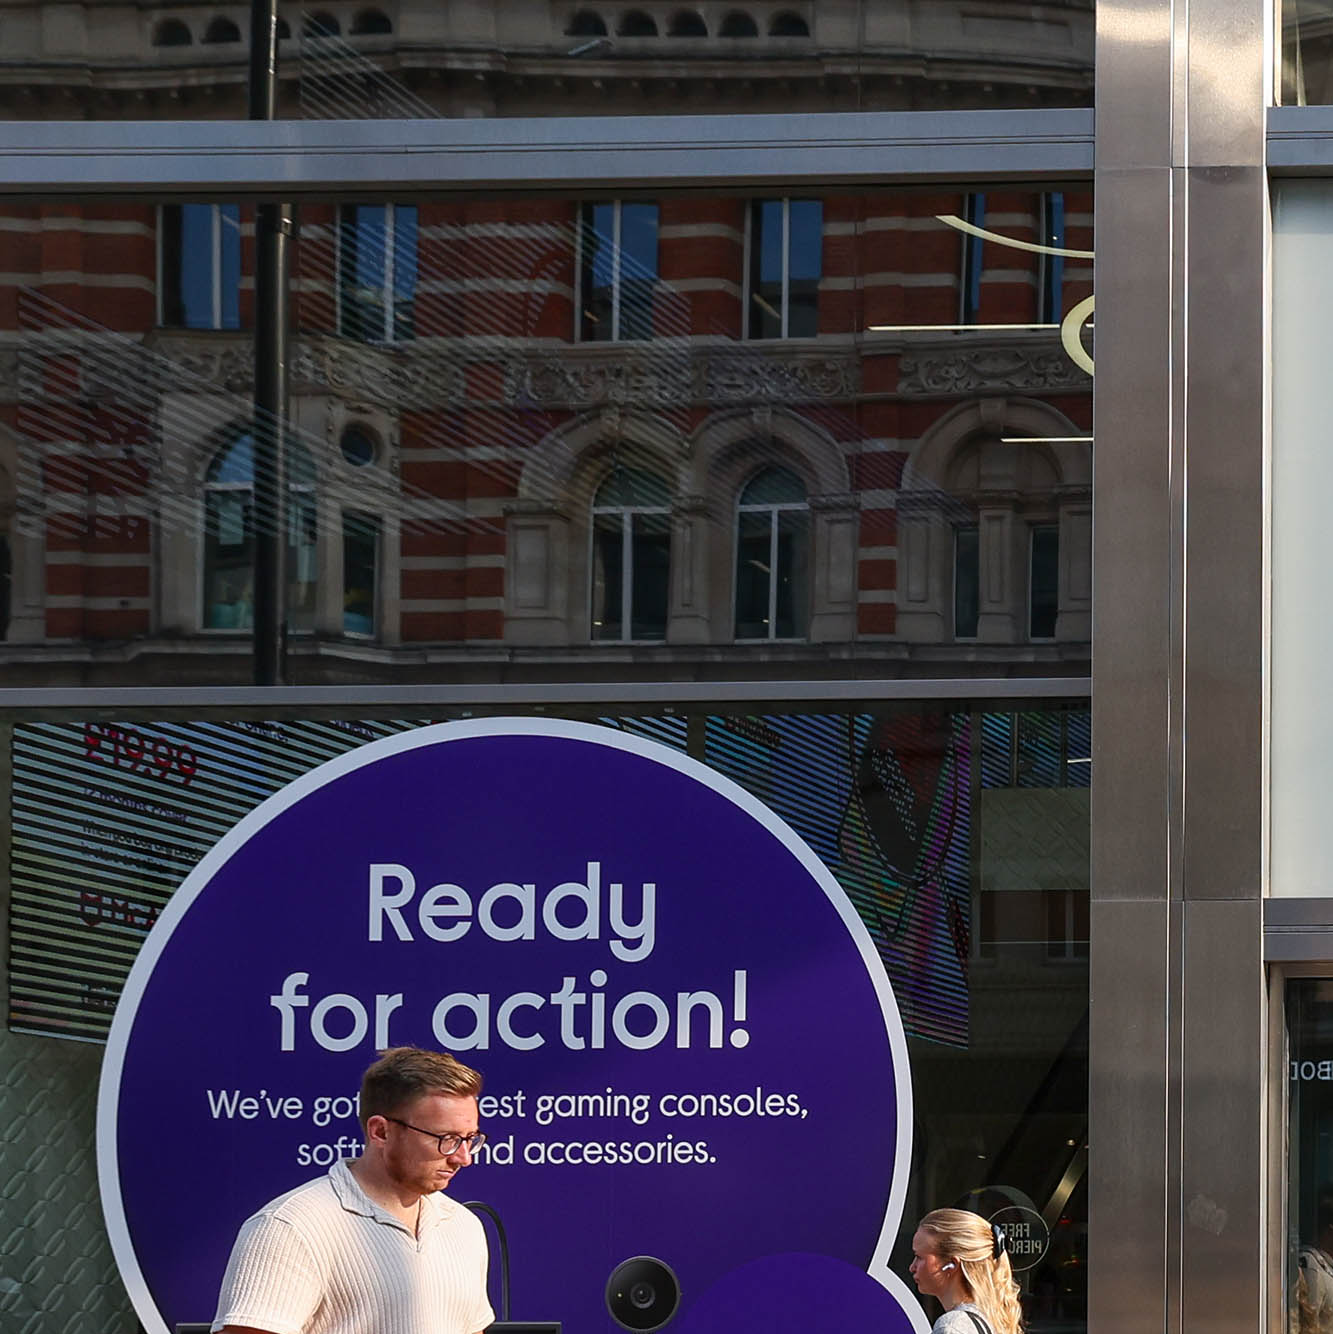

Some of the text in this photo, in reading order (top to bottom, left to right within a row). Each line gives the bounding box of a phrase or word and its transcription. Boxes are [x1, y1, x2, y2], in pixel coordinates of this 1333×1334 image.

[368, 861, 657, 962] Ready
[270, 969, 751, 1052] for action!
[207, 1090, 303, 1119] We've
[475, 1091, 527, 1118] est
[535, 1087, 652, 1125] gaming
[659, 1086, 809, 1120] consoles,
[297, 1134, 718, 1166] soft nd accessories.
